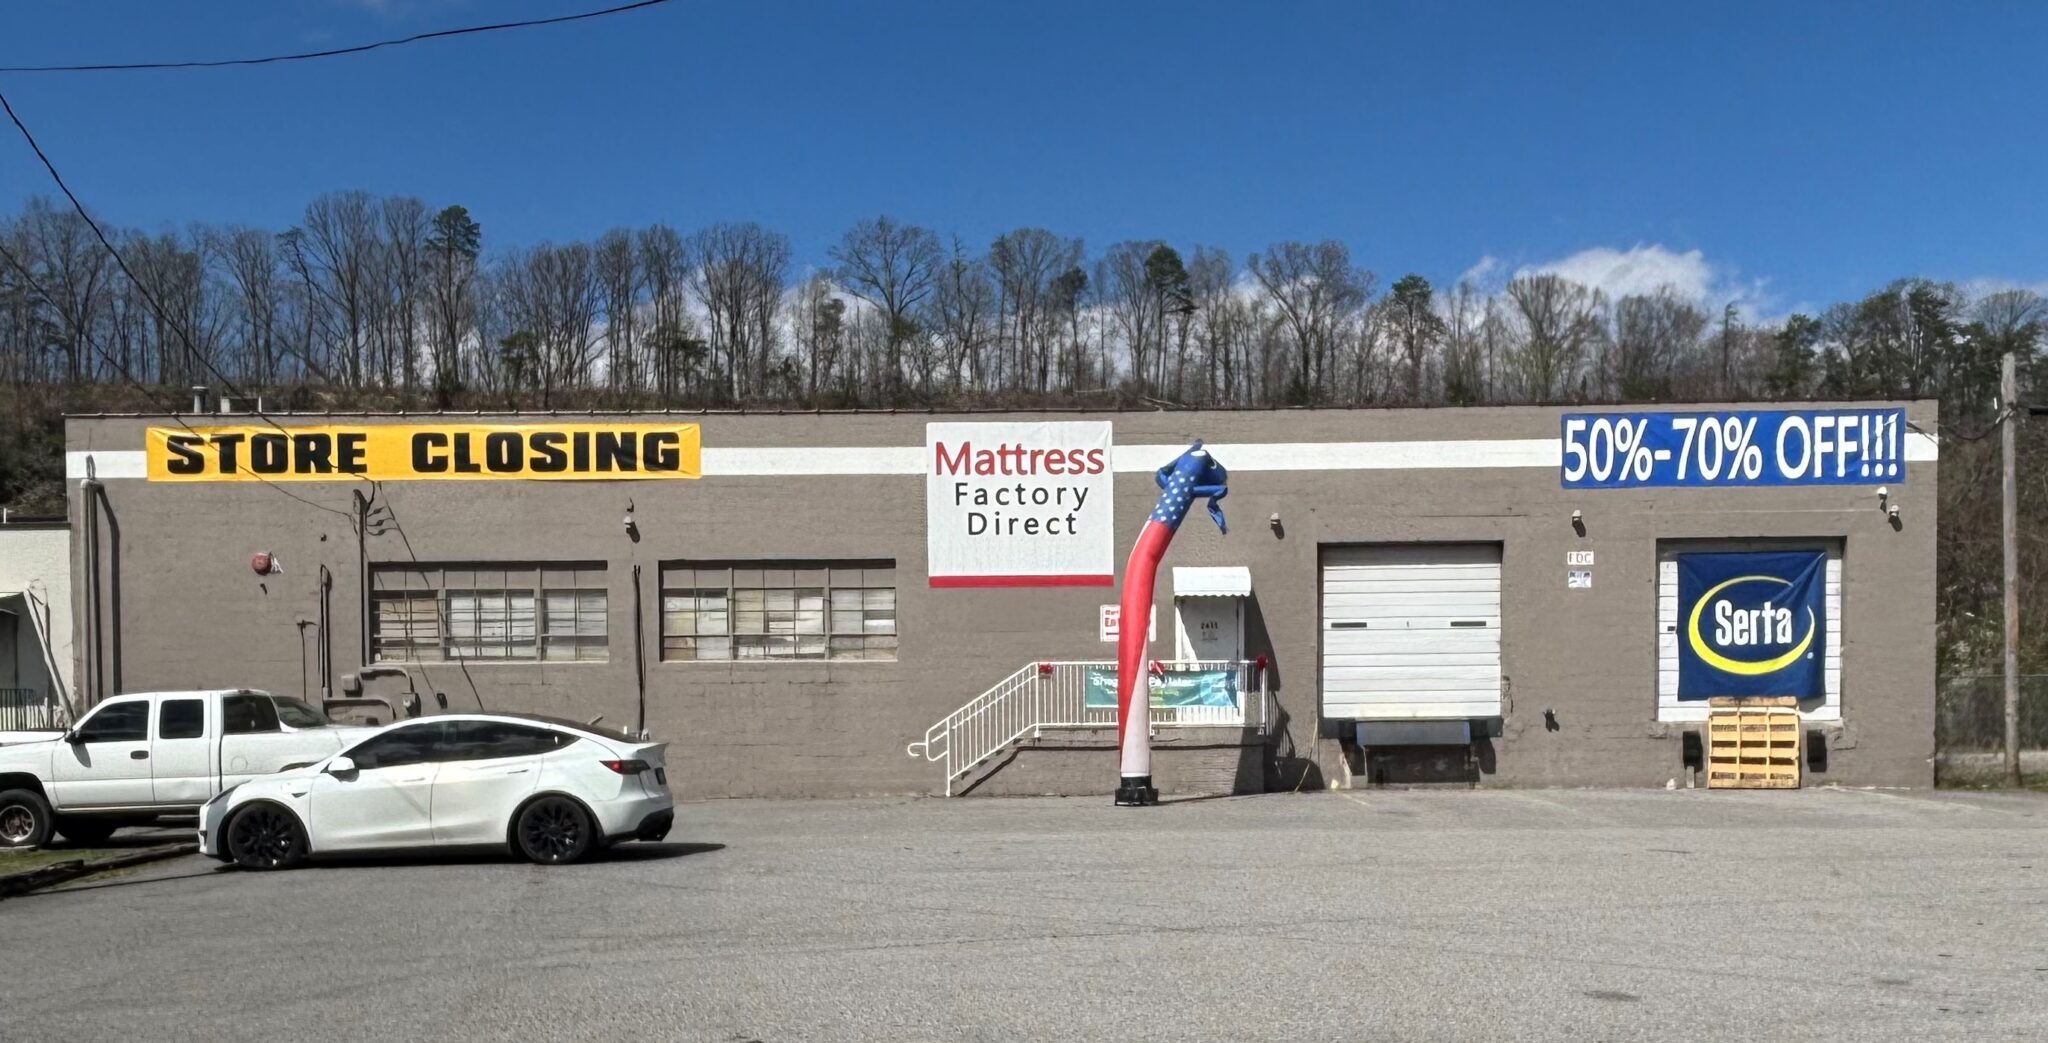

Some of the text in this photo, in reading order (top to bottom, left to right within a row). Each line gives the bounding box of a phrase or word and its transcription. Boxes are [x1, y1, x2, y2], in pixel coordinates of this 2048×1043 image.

[166, 431, 681, 474] STORE CLOSING
[935, 441, 1105, 476] Mattress
[1564, 412, 1900, 482] 50%-70% OFF!!!
[955, 482, 1089, 511] Factory
[968, 511, 1077, 536] Direct
[1714, 599, 1793, 646] Serta
